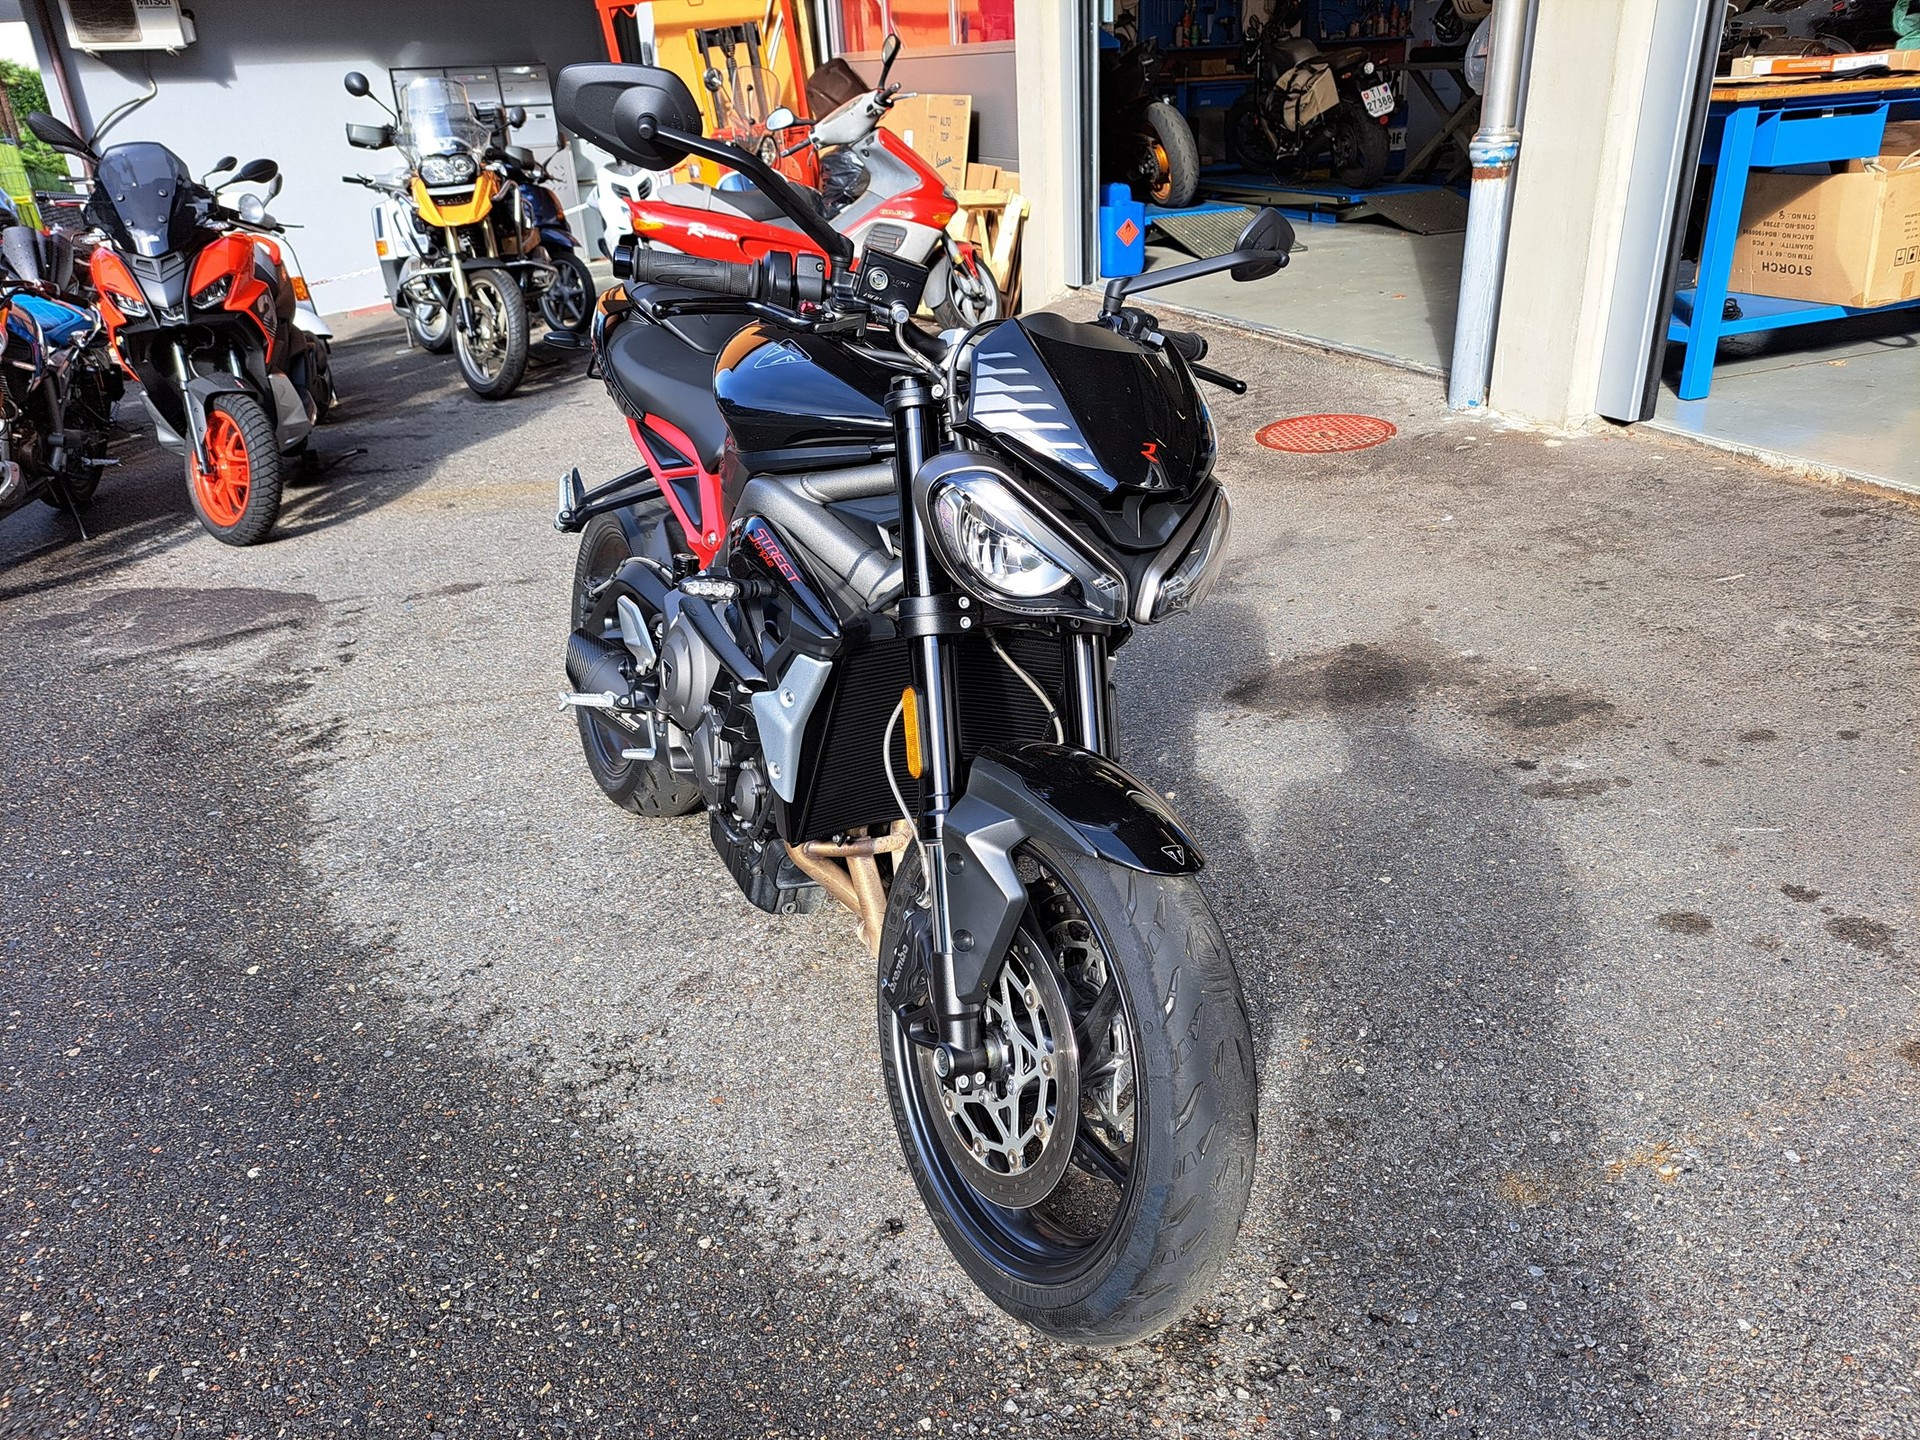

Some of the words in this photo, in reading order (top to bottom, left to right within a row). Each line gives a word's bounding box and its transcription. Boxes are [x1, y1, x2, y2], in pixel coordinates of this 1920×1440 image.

[1367, 94, 1393, 112] 27388
[1762, 261, 1813, 276] STORCH
[748, 528, 801, 583] STREET
[889, 943, 909, 994] brembo
[886, 1065, 917, 1156] MICHELIN
